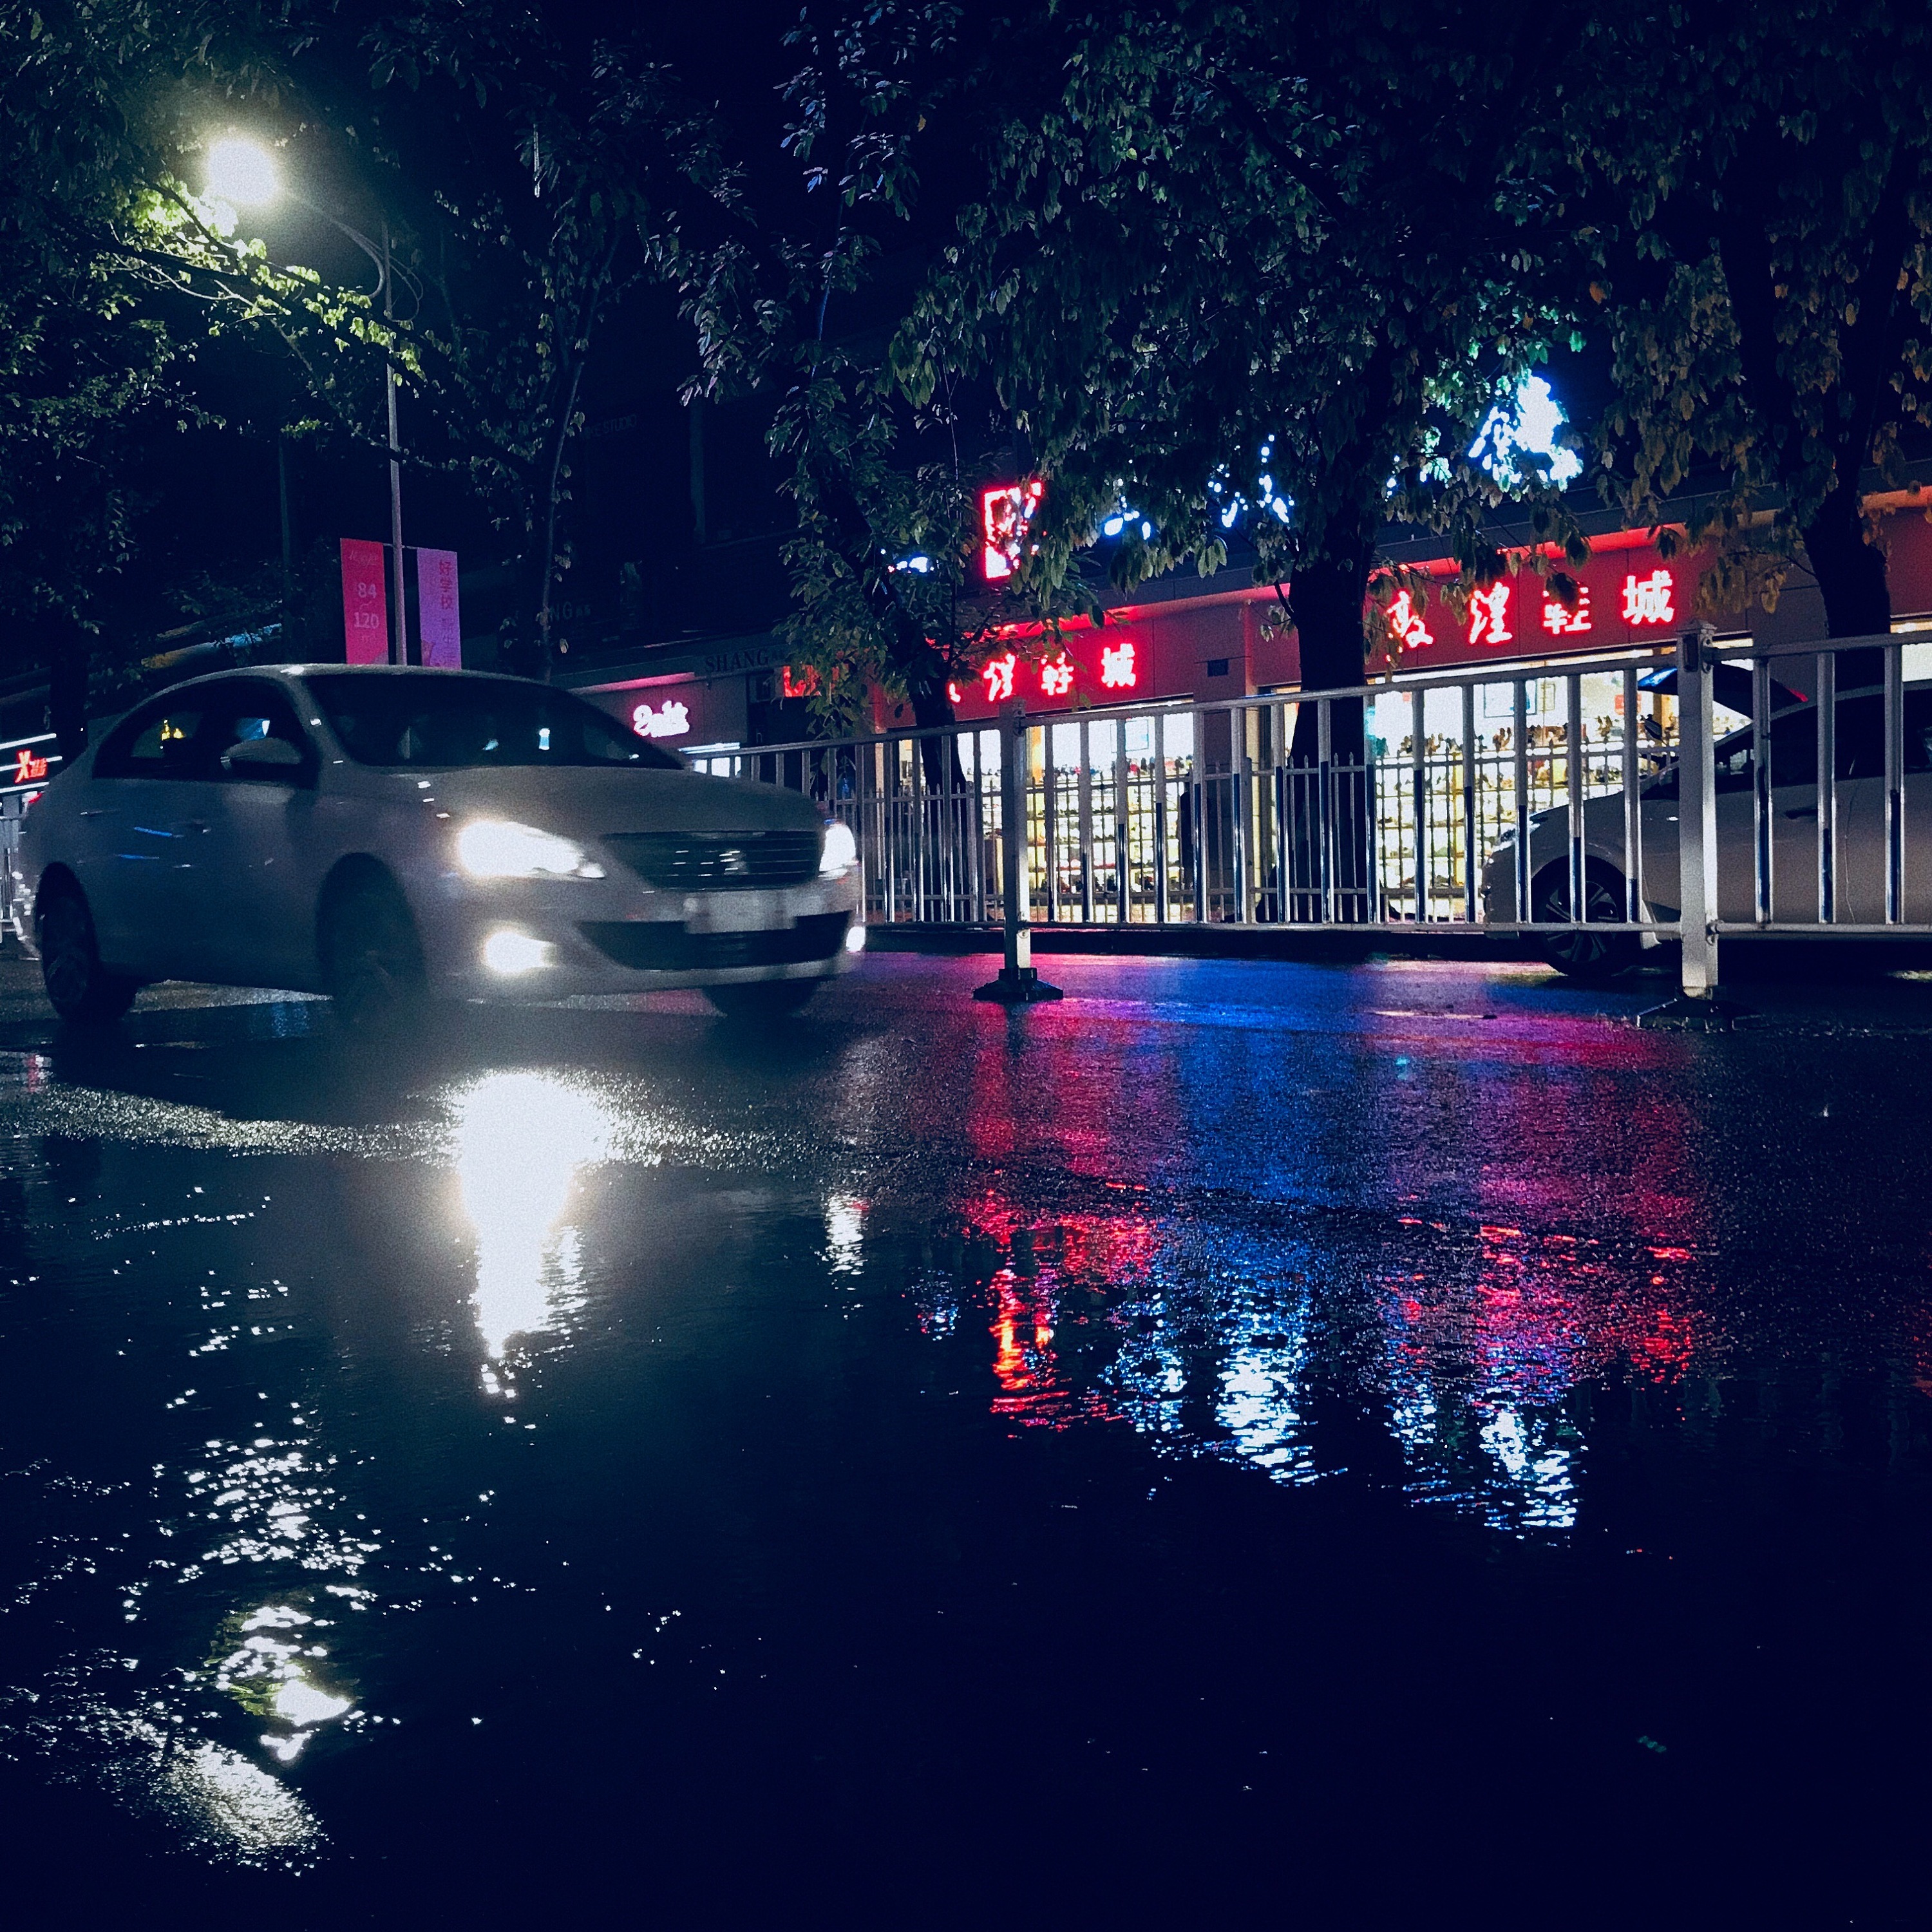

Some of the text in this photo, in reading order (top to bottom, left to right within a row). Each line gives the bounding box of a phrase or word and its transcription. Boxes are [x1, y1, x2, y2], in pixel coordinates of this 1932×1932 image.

[357, 582, 377, 598] 84
[354, 612, 380, 629] 120
[705, 648, 769, 673] SHANG
